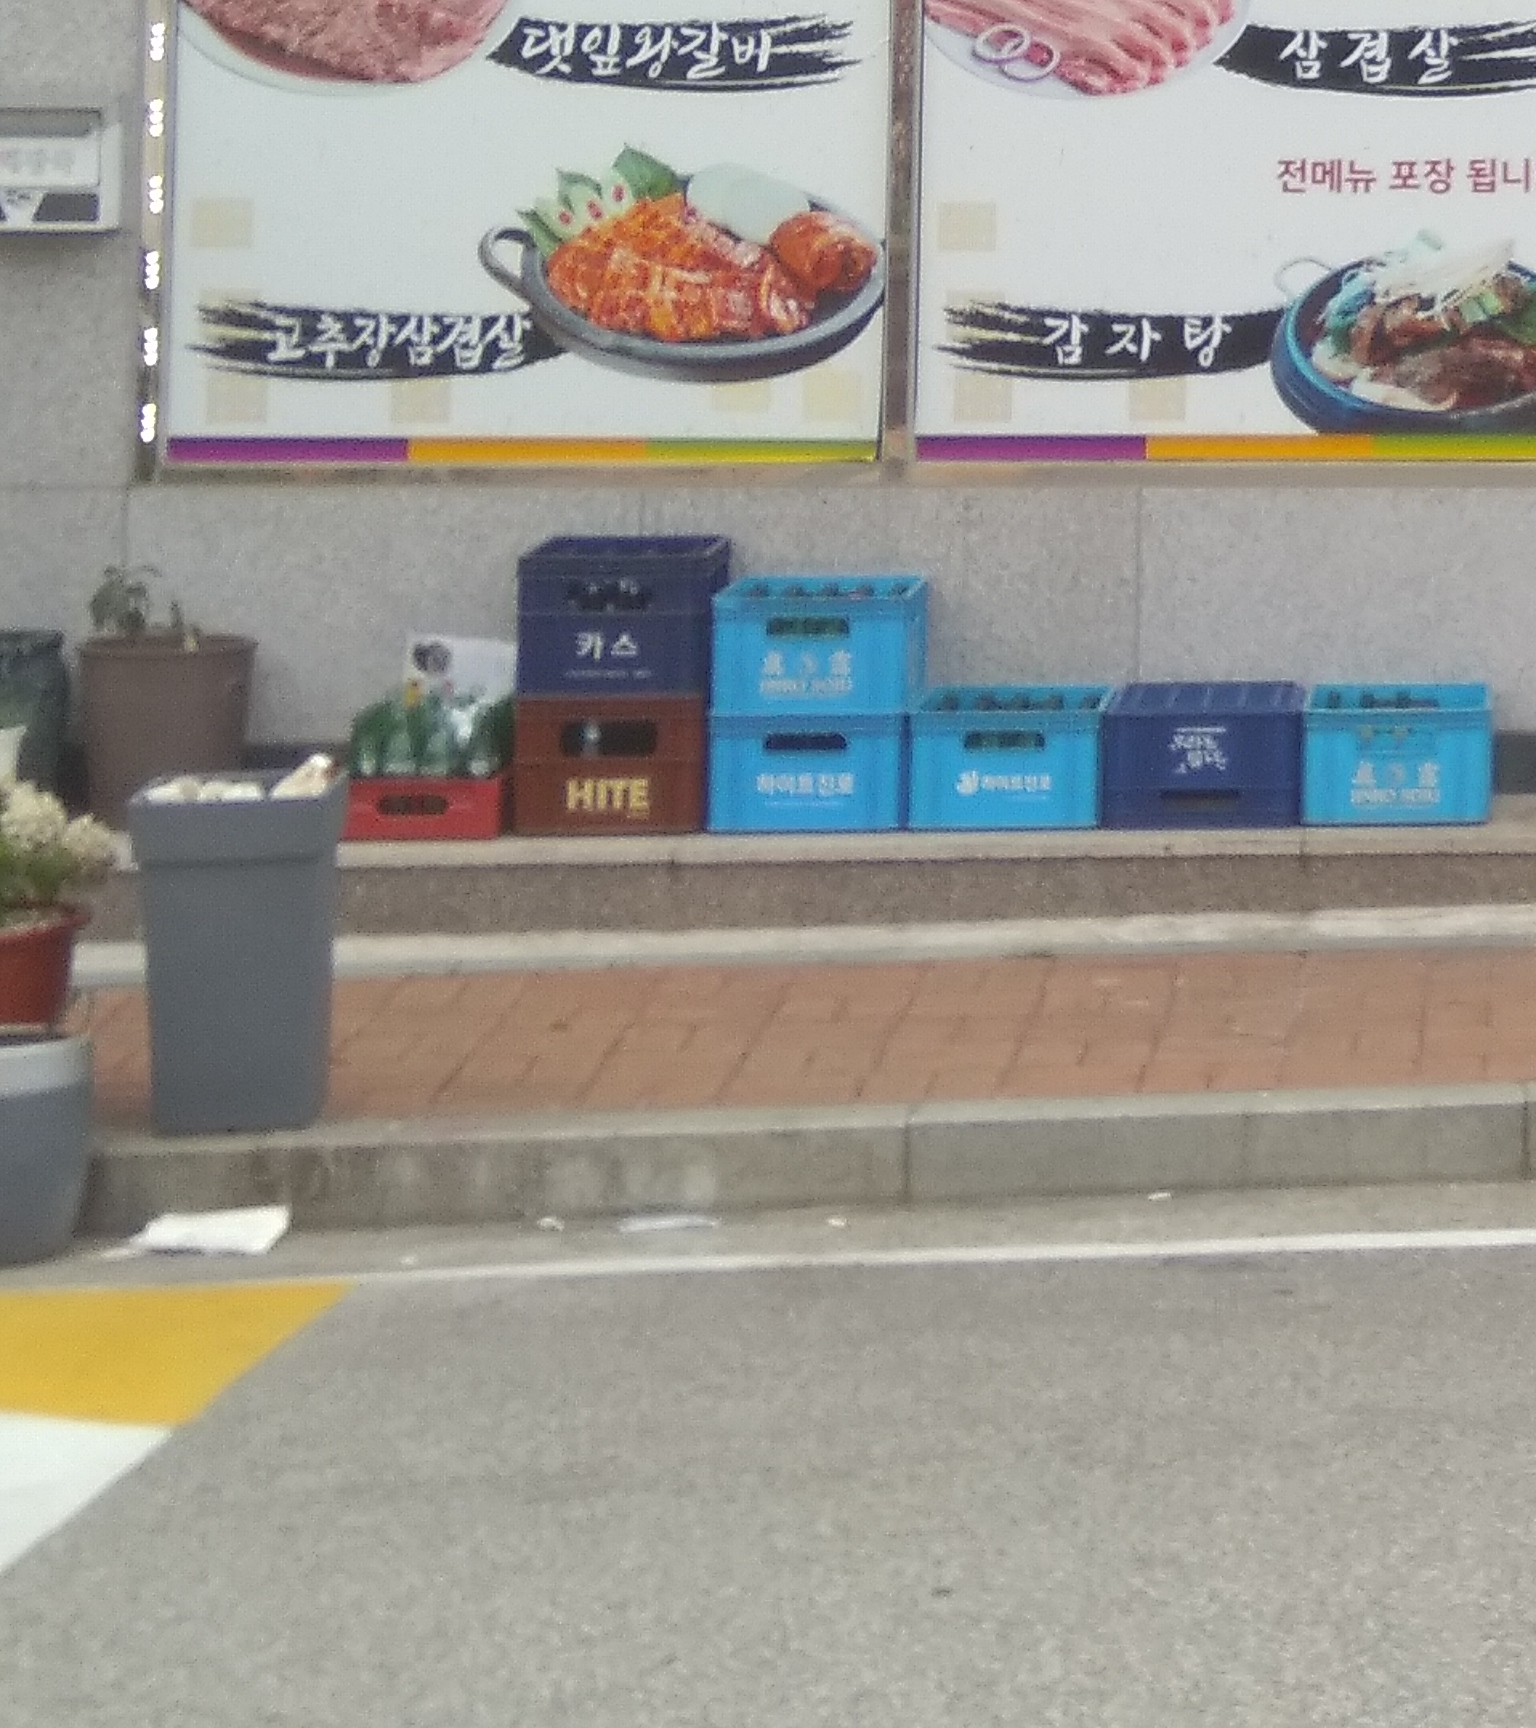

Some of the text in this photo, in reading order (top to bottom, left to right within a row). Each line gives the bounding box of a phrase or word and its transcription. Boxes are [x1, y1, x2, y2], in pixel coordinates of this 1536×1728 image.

[1280, 28, 1462, 84] 삼겹살
[1277, 158, 1378, 194] 전메뉴
[1389, 159, 1454, 194] 포장
[267, 313, 533, 370] 고추장삼겹살
[1043, 314, 1232, 367] 감자탕
[576, 631, 637, 660] 카스
[567, 778, 649, 810] HITE
